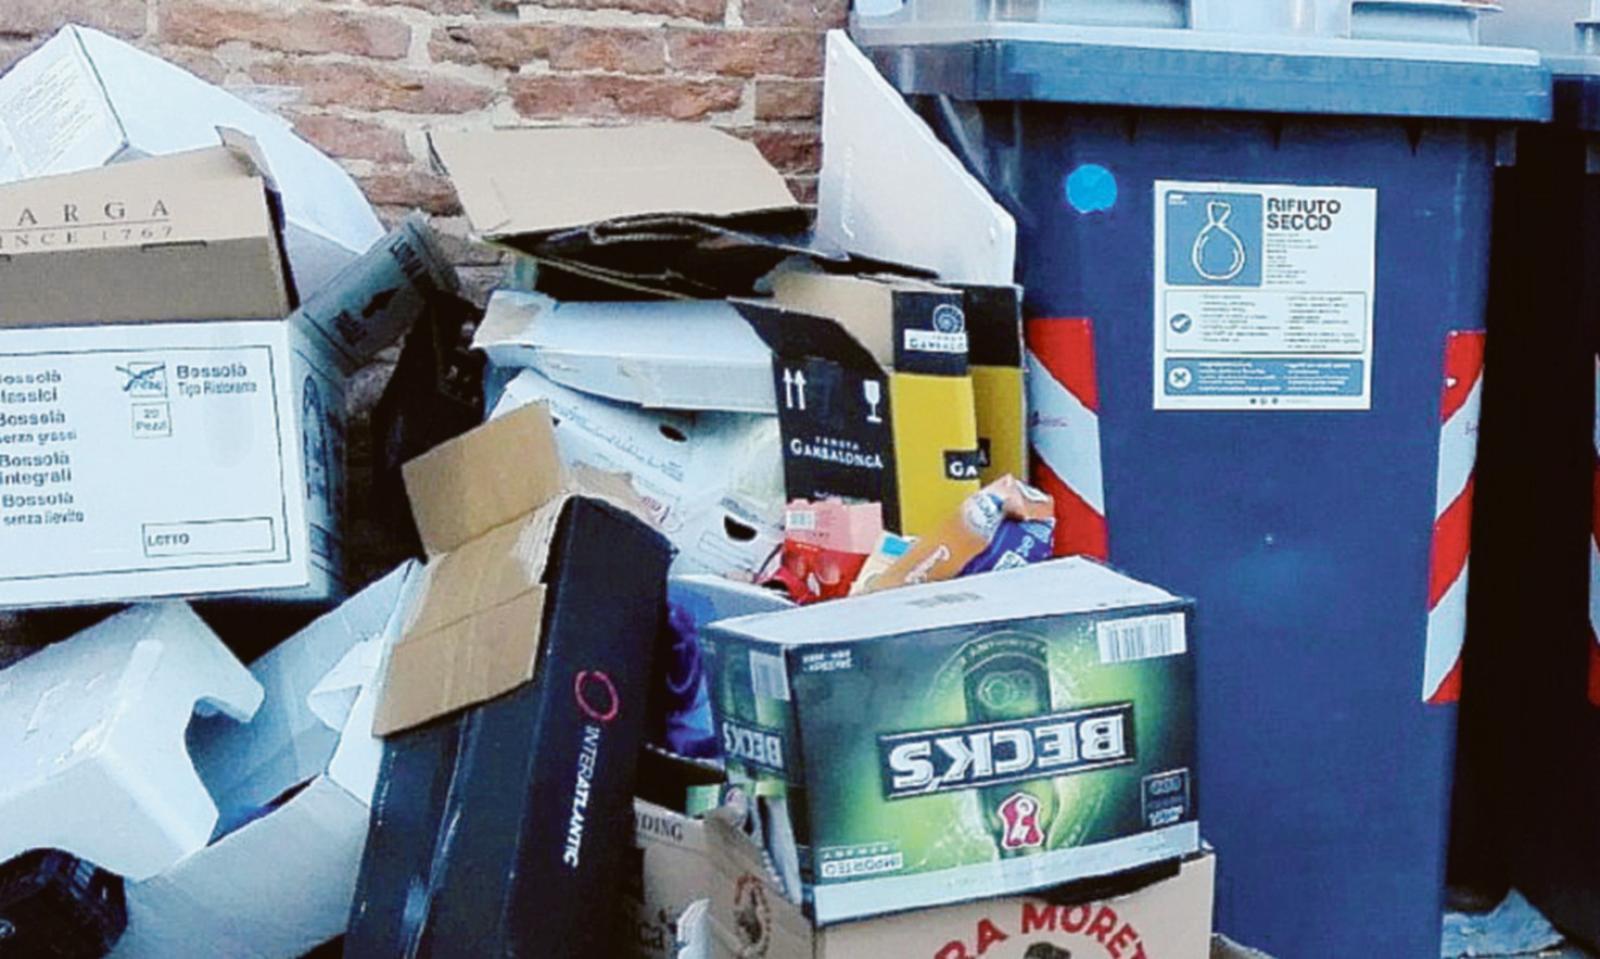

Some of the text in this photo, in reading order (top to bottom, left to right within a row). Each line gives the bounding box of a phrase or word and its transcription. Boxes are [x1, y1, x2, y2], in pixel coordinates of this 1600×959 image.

[1267, 198, 1342, 215] RIFIUTO
[1266, 213, 1332, 231] SECCO
[102, 226, 173, 241] 1767
[0, 369, 62, 385] ossolà
[176, 361, 248, 380] Bossolà
[0, 386, 57, 404] lassici
[177, 380, 202, 398] Tipo
[950, 461, 978, 477] GA
[2, 491, 74, 508] Bossolà
[147, 533, 190, 547] LOTTO
[889, 714, 1126, 791] BECK'S
[562, 724, 601, 869] INTERATLANTIC
